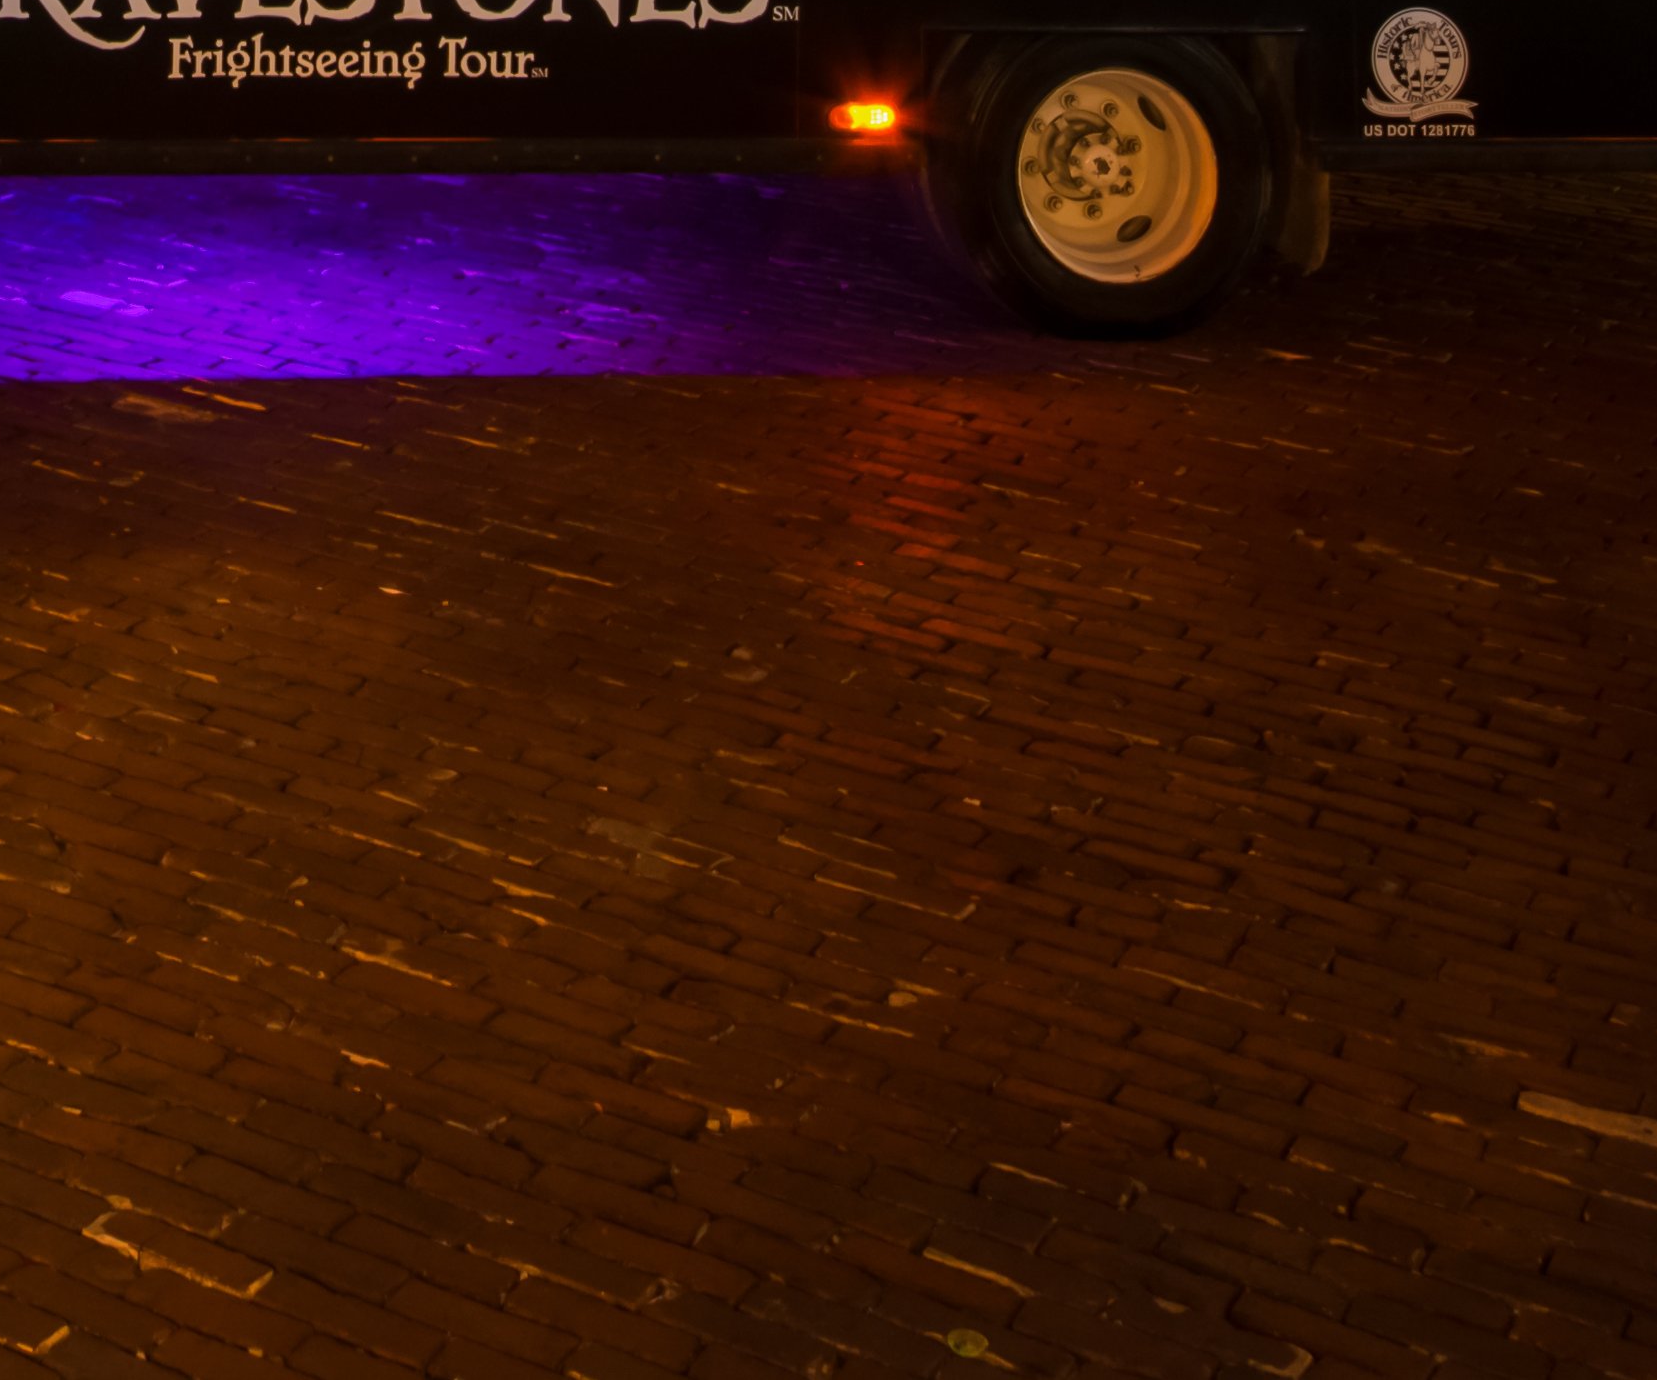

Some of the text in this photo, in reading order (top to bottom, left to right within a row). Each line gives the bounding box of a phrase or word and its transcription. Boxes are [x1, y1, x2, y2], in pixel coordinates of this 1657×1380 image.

[1376, 16, 1463, 60] Historic Tours
[167, 33, 426, 89] Frightseeing
[438, 35, 535, 80] Tour
[1364, 124, 1475, 137] US DOT 1281776
